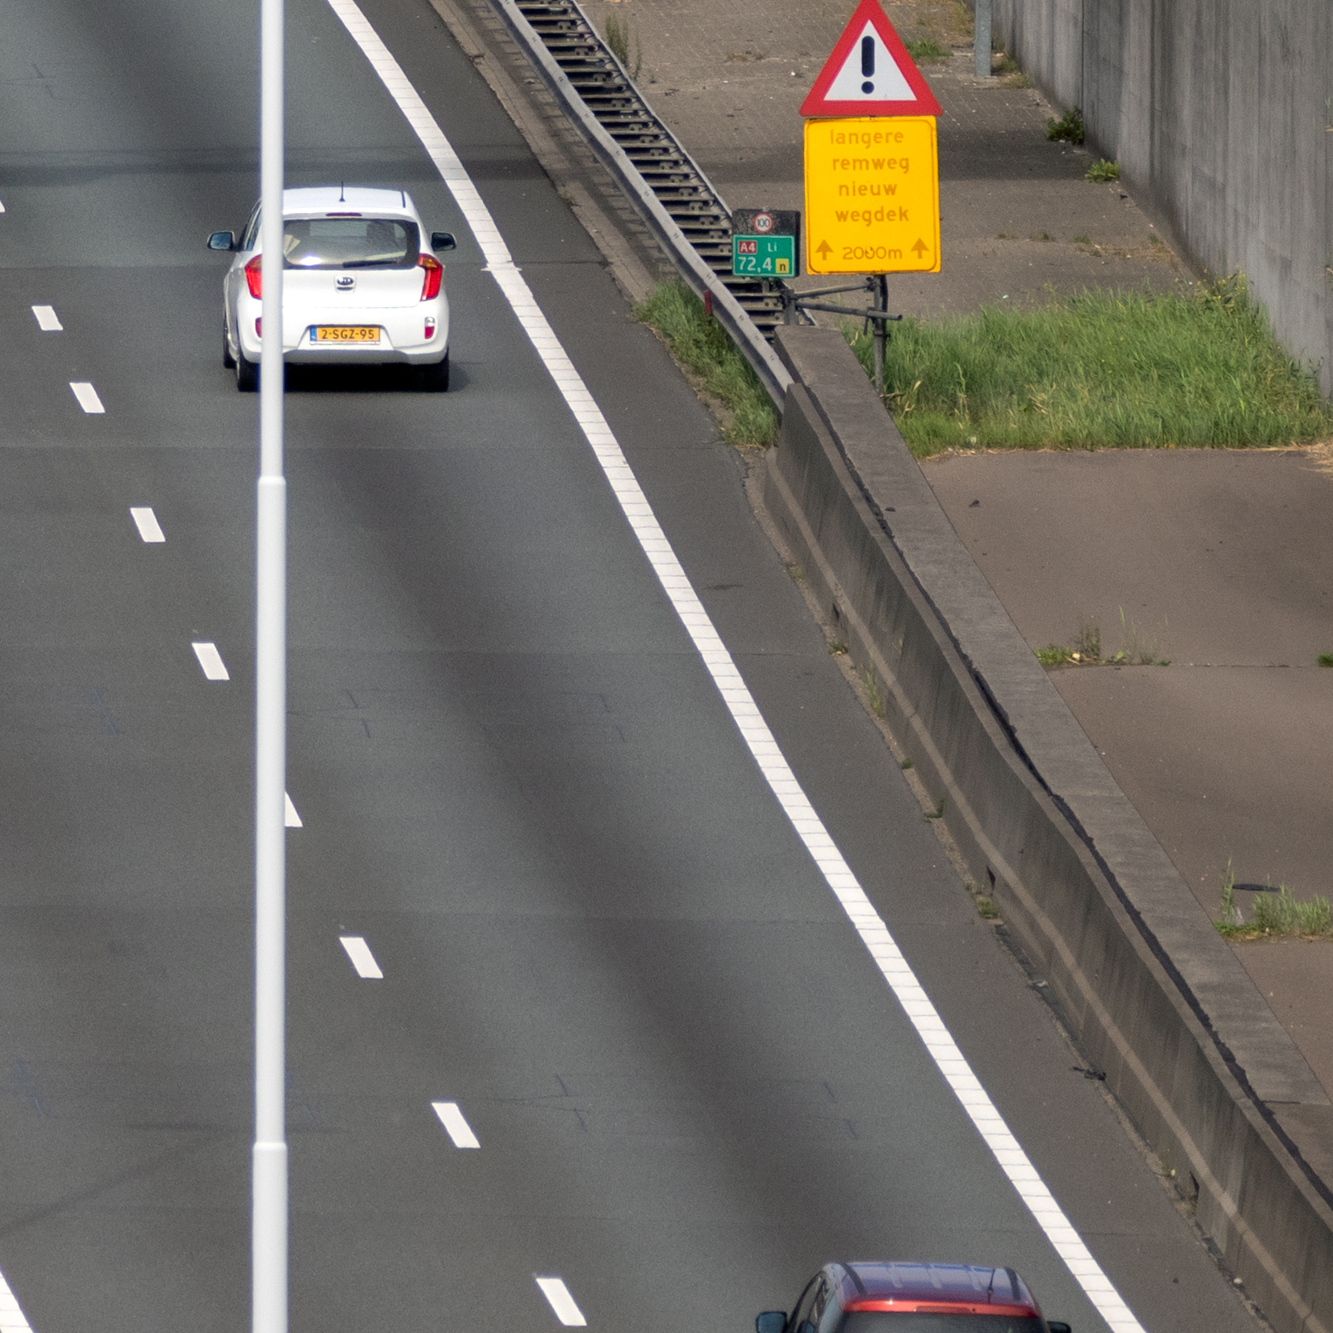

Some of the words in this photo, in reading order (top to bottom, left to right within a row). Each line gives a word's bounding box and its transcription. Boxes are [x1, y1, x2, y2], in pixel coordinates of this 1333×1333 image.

[829, 129, 904, 150] langere
[832, 157, 910, 175] remweg
[838, 181, 898, 197] nieuw
[834, 205, 910, 227] wegdek
[740, 242, 756, 254] A4
[768, 242, 778, 252] Li
[738, 257, 773, 273] 72,4
[321, 328, 375, 340] 2-SGZ-95
